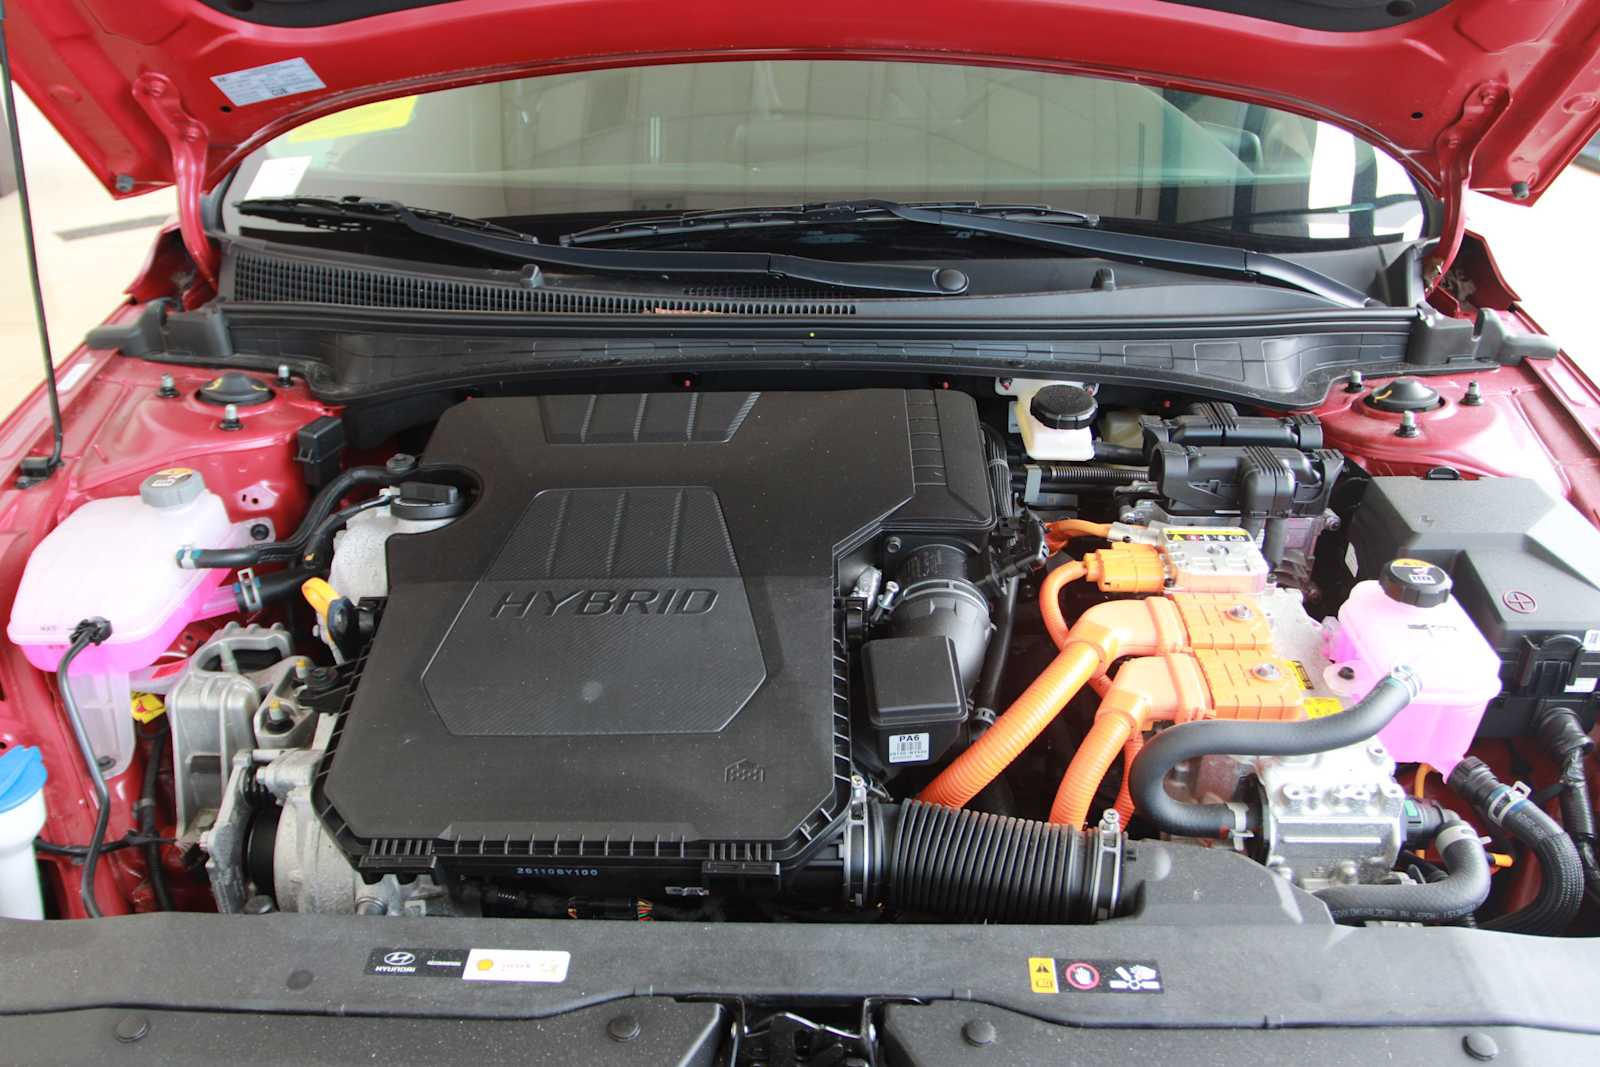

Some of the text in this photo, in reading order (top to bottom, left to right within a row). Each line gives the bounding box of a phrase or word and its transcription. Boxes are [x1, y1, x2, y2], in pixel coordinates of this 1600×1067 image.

[488, 588, 719, 619] HYBRID
[899, 734, 921, 742] PA6
[375, 965, 416, 973] HYUNDAI
